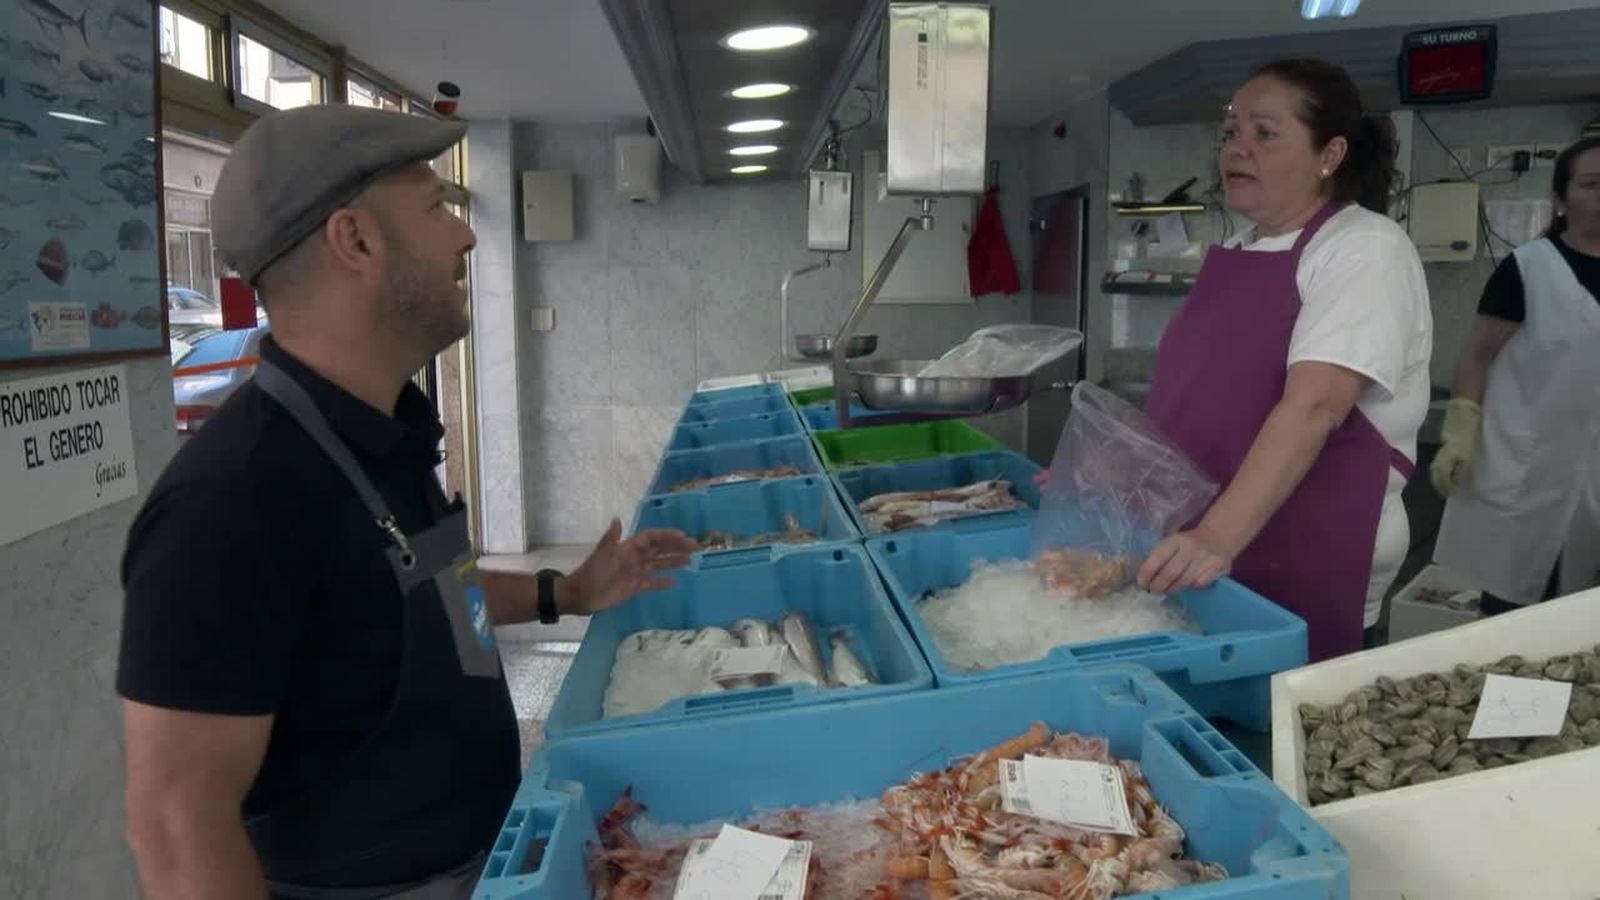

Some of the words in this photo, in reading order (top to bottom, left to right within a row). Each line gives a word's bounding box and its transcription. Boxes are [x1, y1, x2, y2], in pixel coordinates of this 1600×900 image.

[1440, 30, 1477, 42] TURNO
[0, 384, 72, 427] ROHIBIDO
[76, 375, 120, 410] TOCAR
[24, 436, 44, 470] EL
[49, 421, 103, 461] GENERO
[95, 459, 126, 491] Gracias
